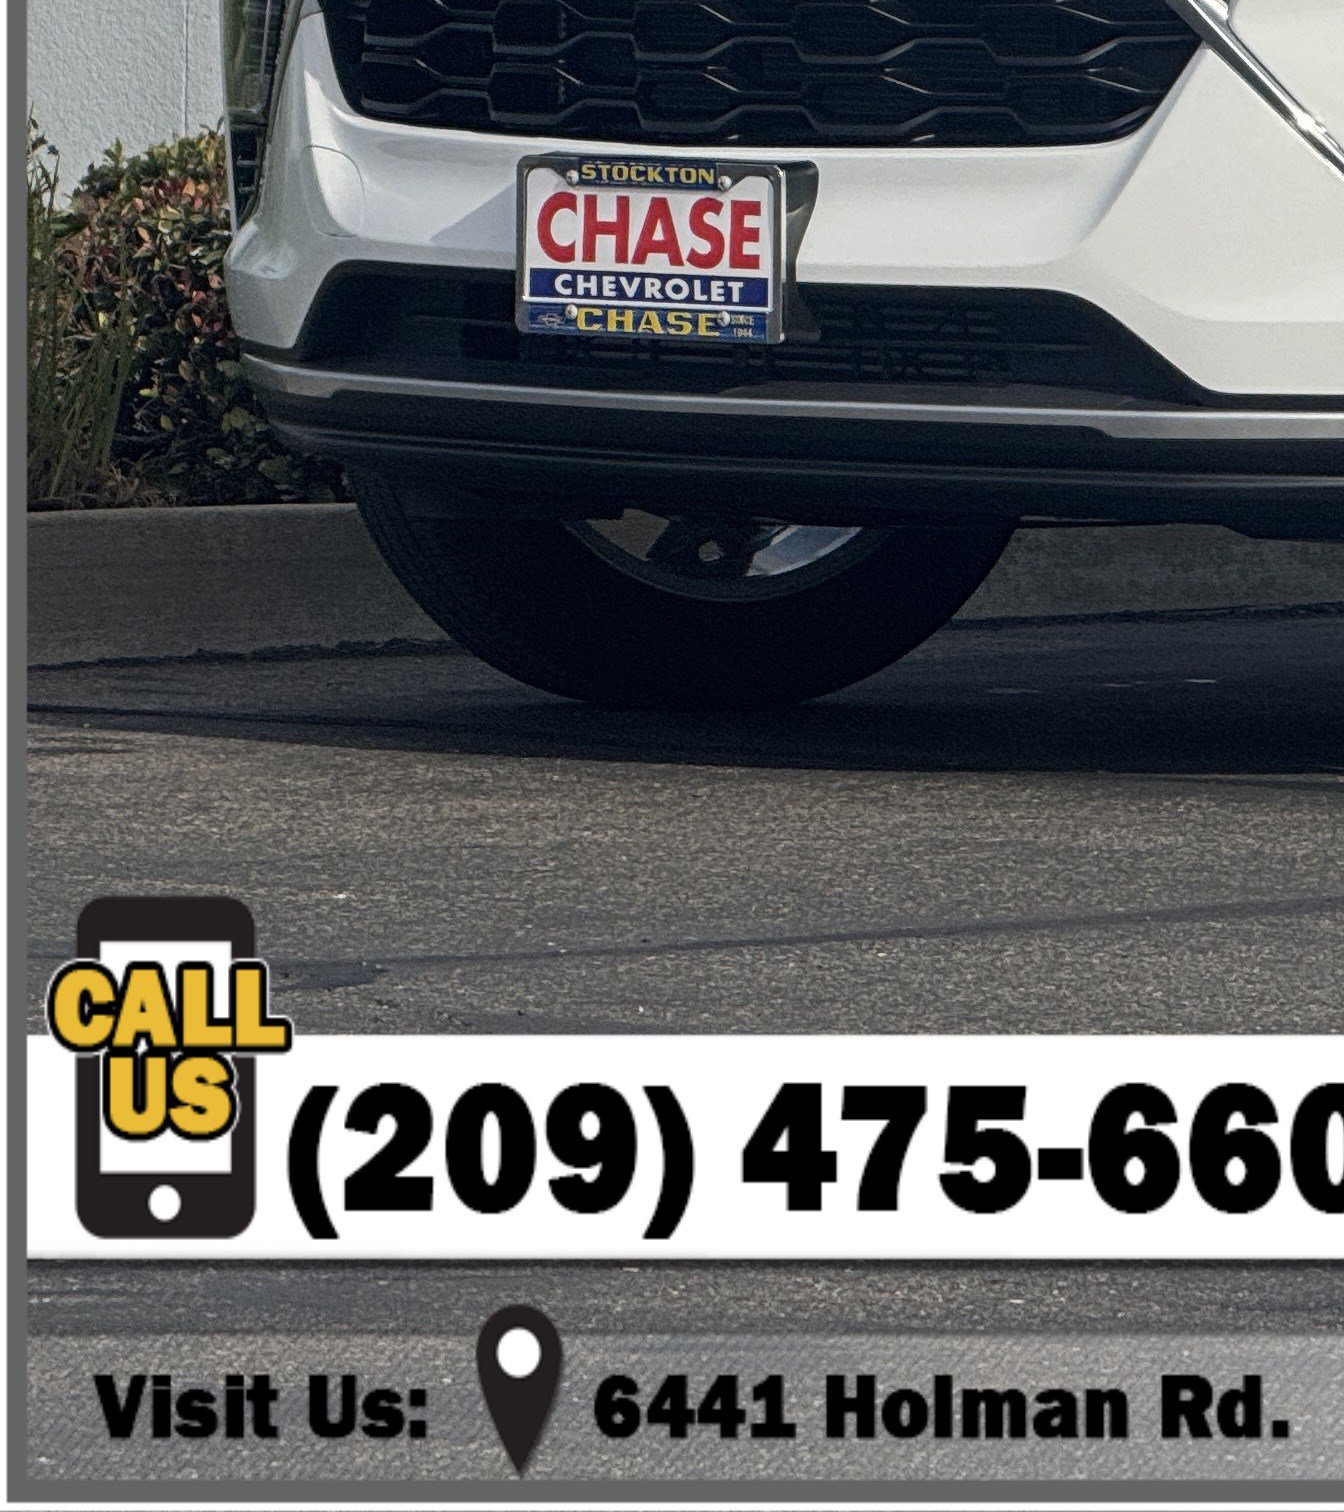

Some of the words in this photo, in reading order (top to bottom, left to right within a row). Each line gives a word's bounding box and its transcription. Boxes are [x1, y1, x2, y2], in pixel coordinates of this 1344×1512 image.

[580, 162, 715, 185] STOCKTON
[536, 191, 762, 270] CHASE
[554, 273, 744, 303] CHEVROLET
[576, 307, 721, 337] CHASE
